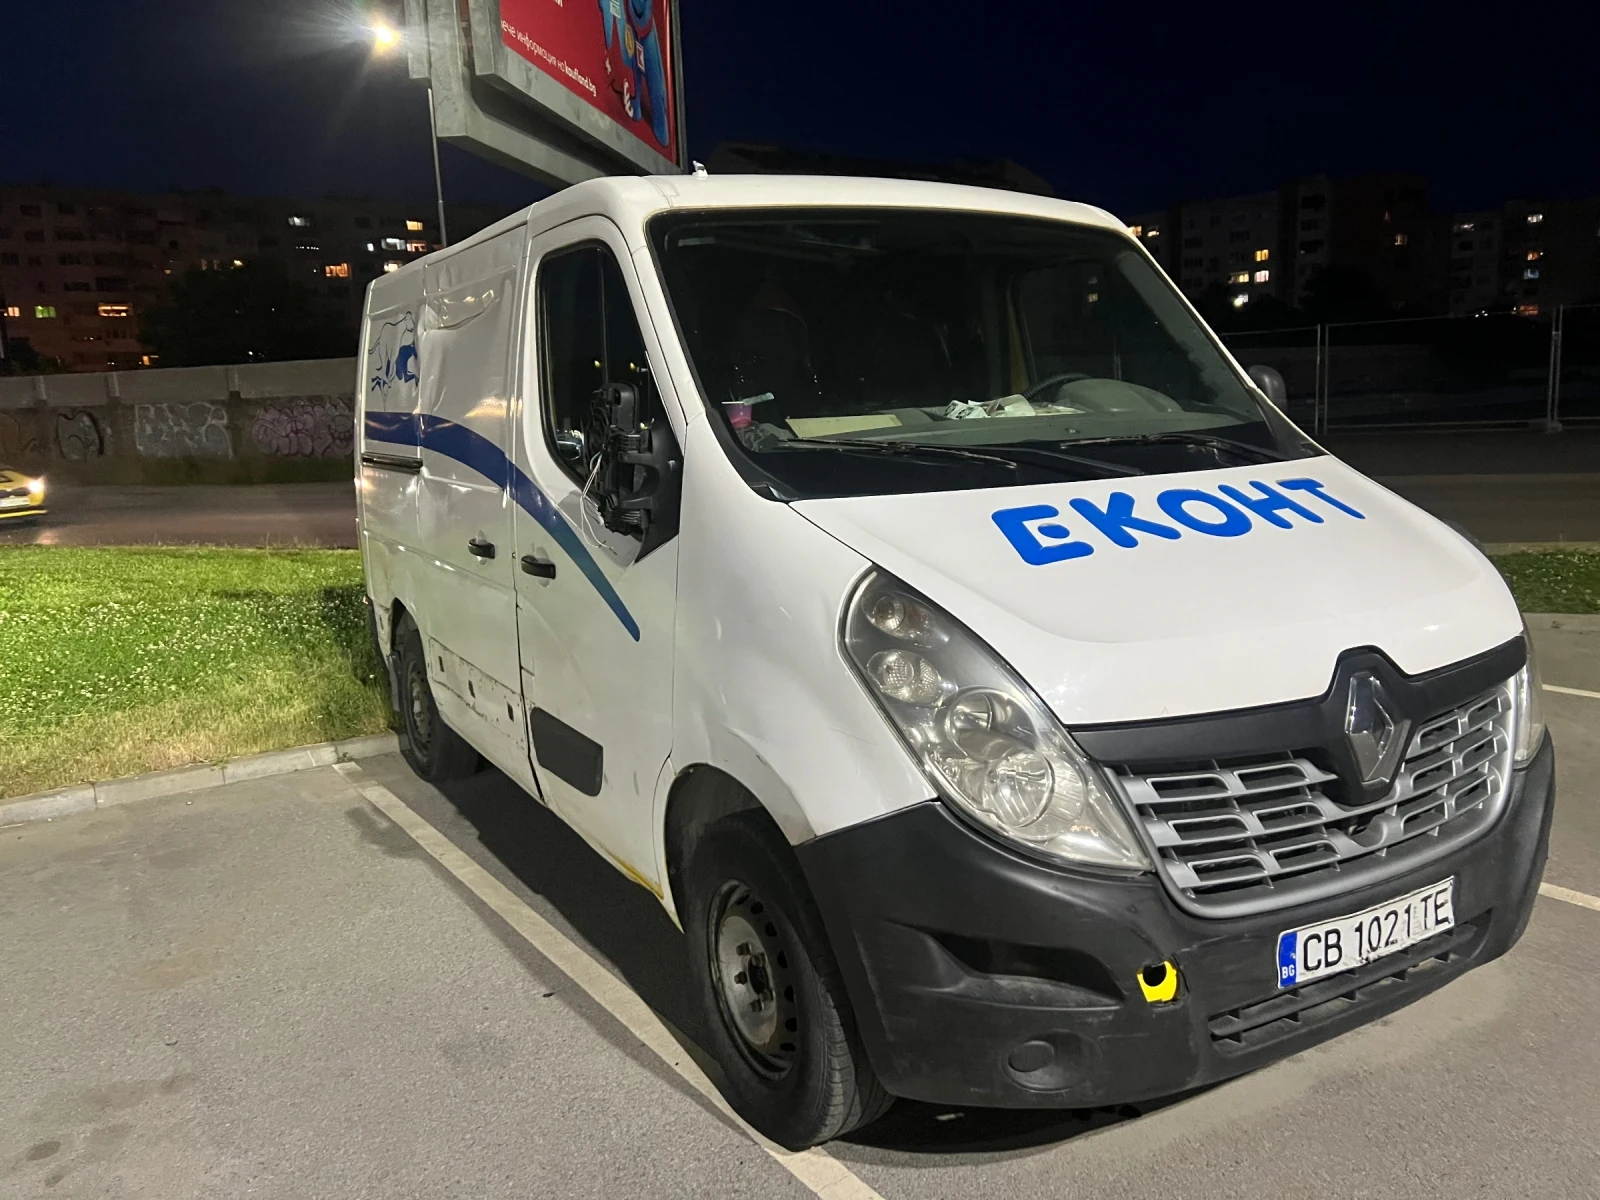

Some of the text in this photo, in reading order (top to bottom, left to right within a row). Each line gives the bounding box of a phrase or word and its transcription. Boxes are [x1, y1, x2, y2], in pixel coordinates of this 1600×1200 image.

[500, 19, 516, 38] ече
[516, 30, 557, 67] информация
[564, 60, 597, 97] kaufland.bg
[991, 477, 1366, 566] ЕКОНТ
[1303, 887, 1450, 971] CB 1021 TE
[1281, 964, 1296, 979] BG
